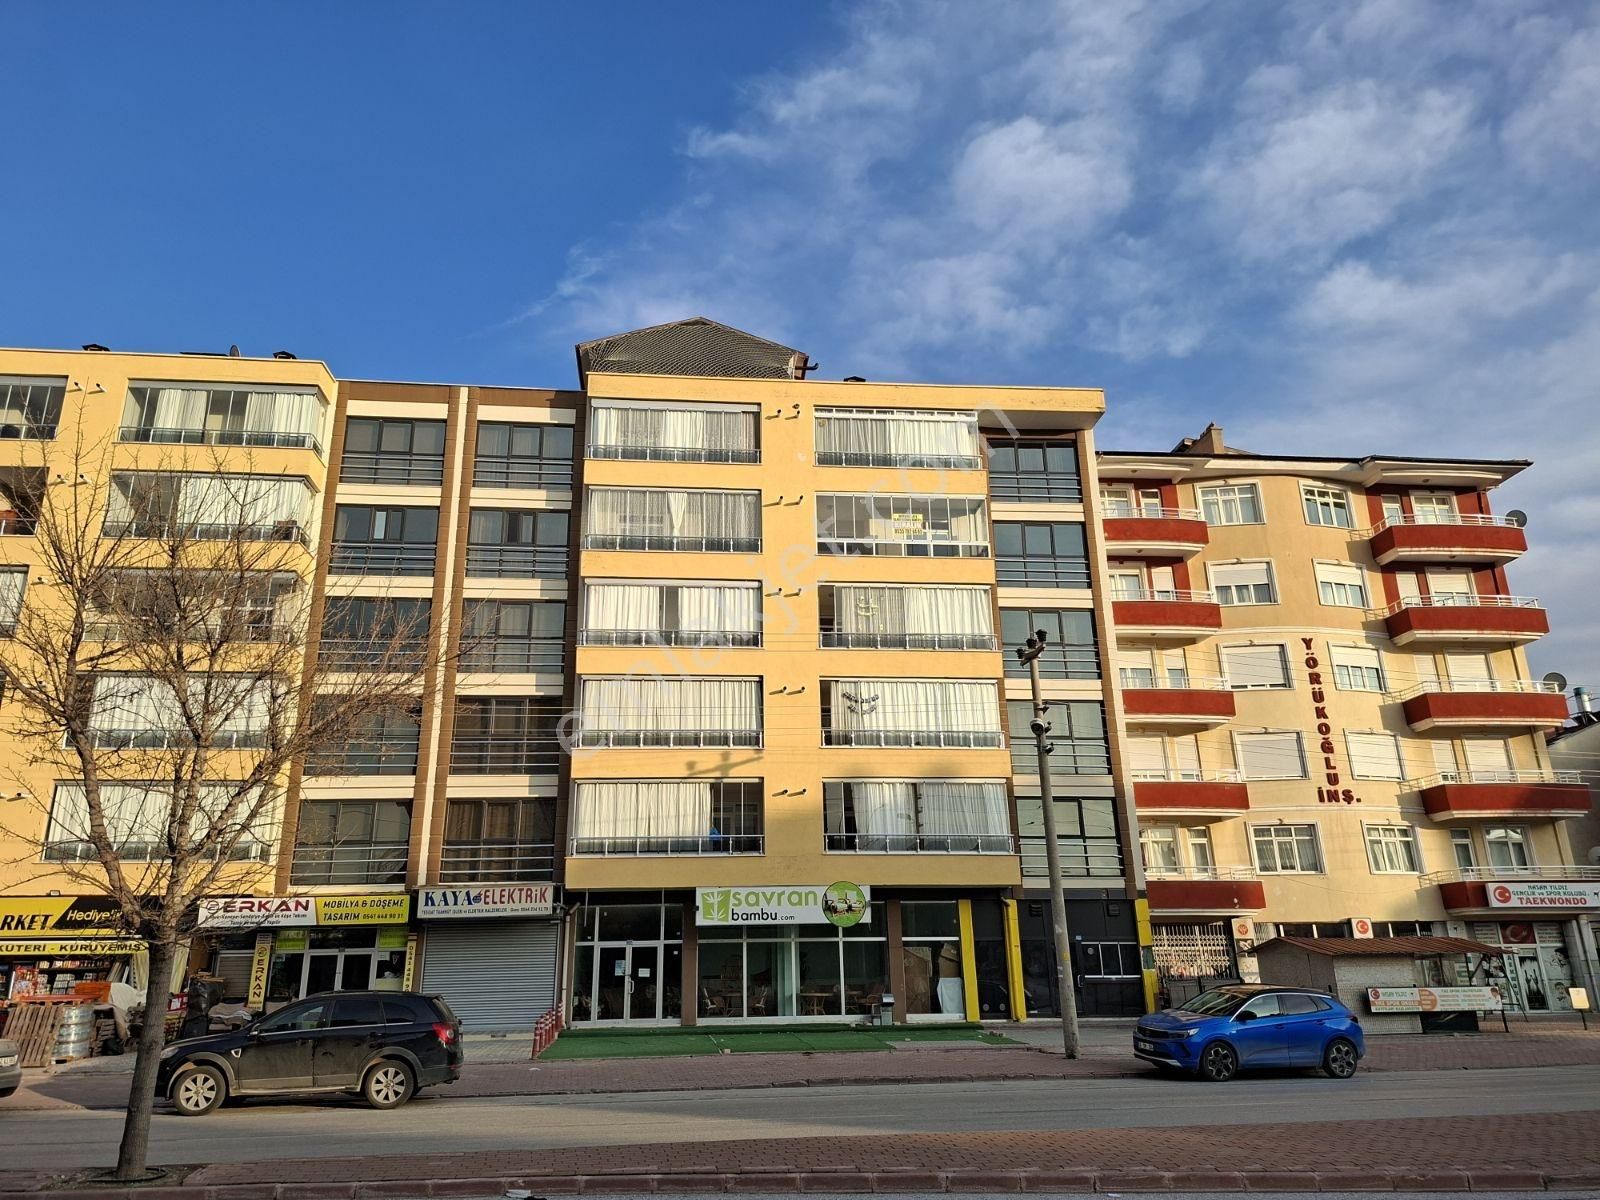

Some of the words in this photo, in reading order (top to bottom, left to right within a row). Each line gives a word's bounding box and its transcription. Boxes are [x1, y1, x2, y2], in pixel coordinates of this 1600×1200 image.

[1301, 638, 1339, 786] YÖRÜKOĞLU
[1317, 787, 1362, 804] İNŞ.
[223, 899, 310, 912] ERKAN
[323, 898, 359, 908] MOBİLYA
[361, 899, 368, 907] &
[423, 890, 474, 906] KAYA
[731, 888, 818, 908] savran
[1517, 897, 1587, 905] TAEKWONDO
[323, 912, 360, 921] TASARIM
[253, 958, 265, 998] ERKAN
